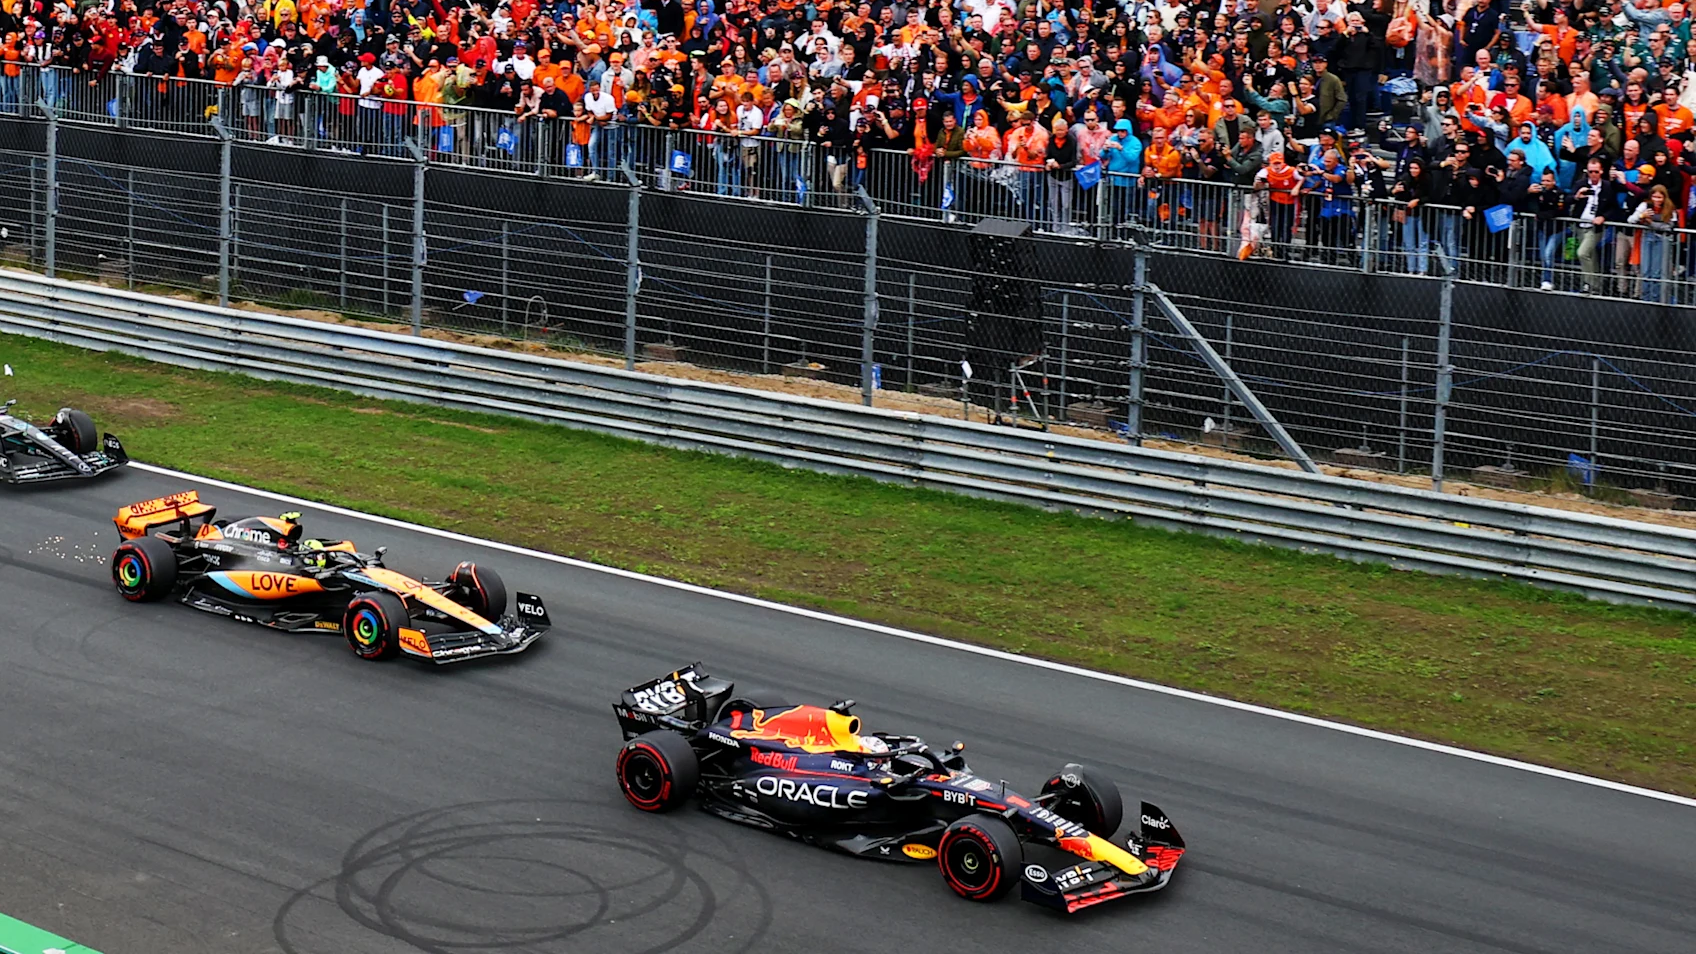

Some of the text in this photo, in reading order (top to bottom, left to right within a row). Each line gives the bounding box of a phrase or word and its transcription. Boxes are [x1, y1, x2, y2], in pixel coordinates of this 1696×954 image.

[224, 524, 271, 544] Chrome
[251, 573, 298, 593] LOVE
[518, 602, 545, 617] VELO
[708, 732, 740, 748] HONDA
[830, 759, 854, 772] ROKT
[756, 776, 869, 809] ORACLE
[943, 790, 976, 806] BYBIT
[1141, 815, 1167, 830] Claro
[1028, 868, 1046, 879] Esso
